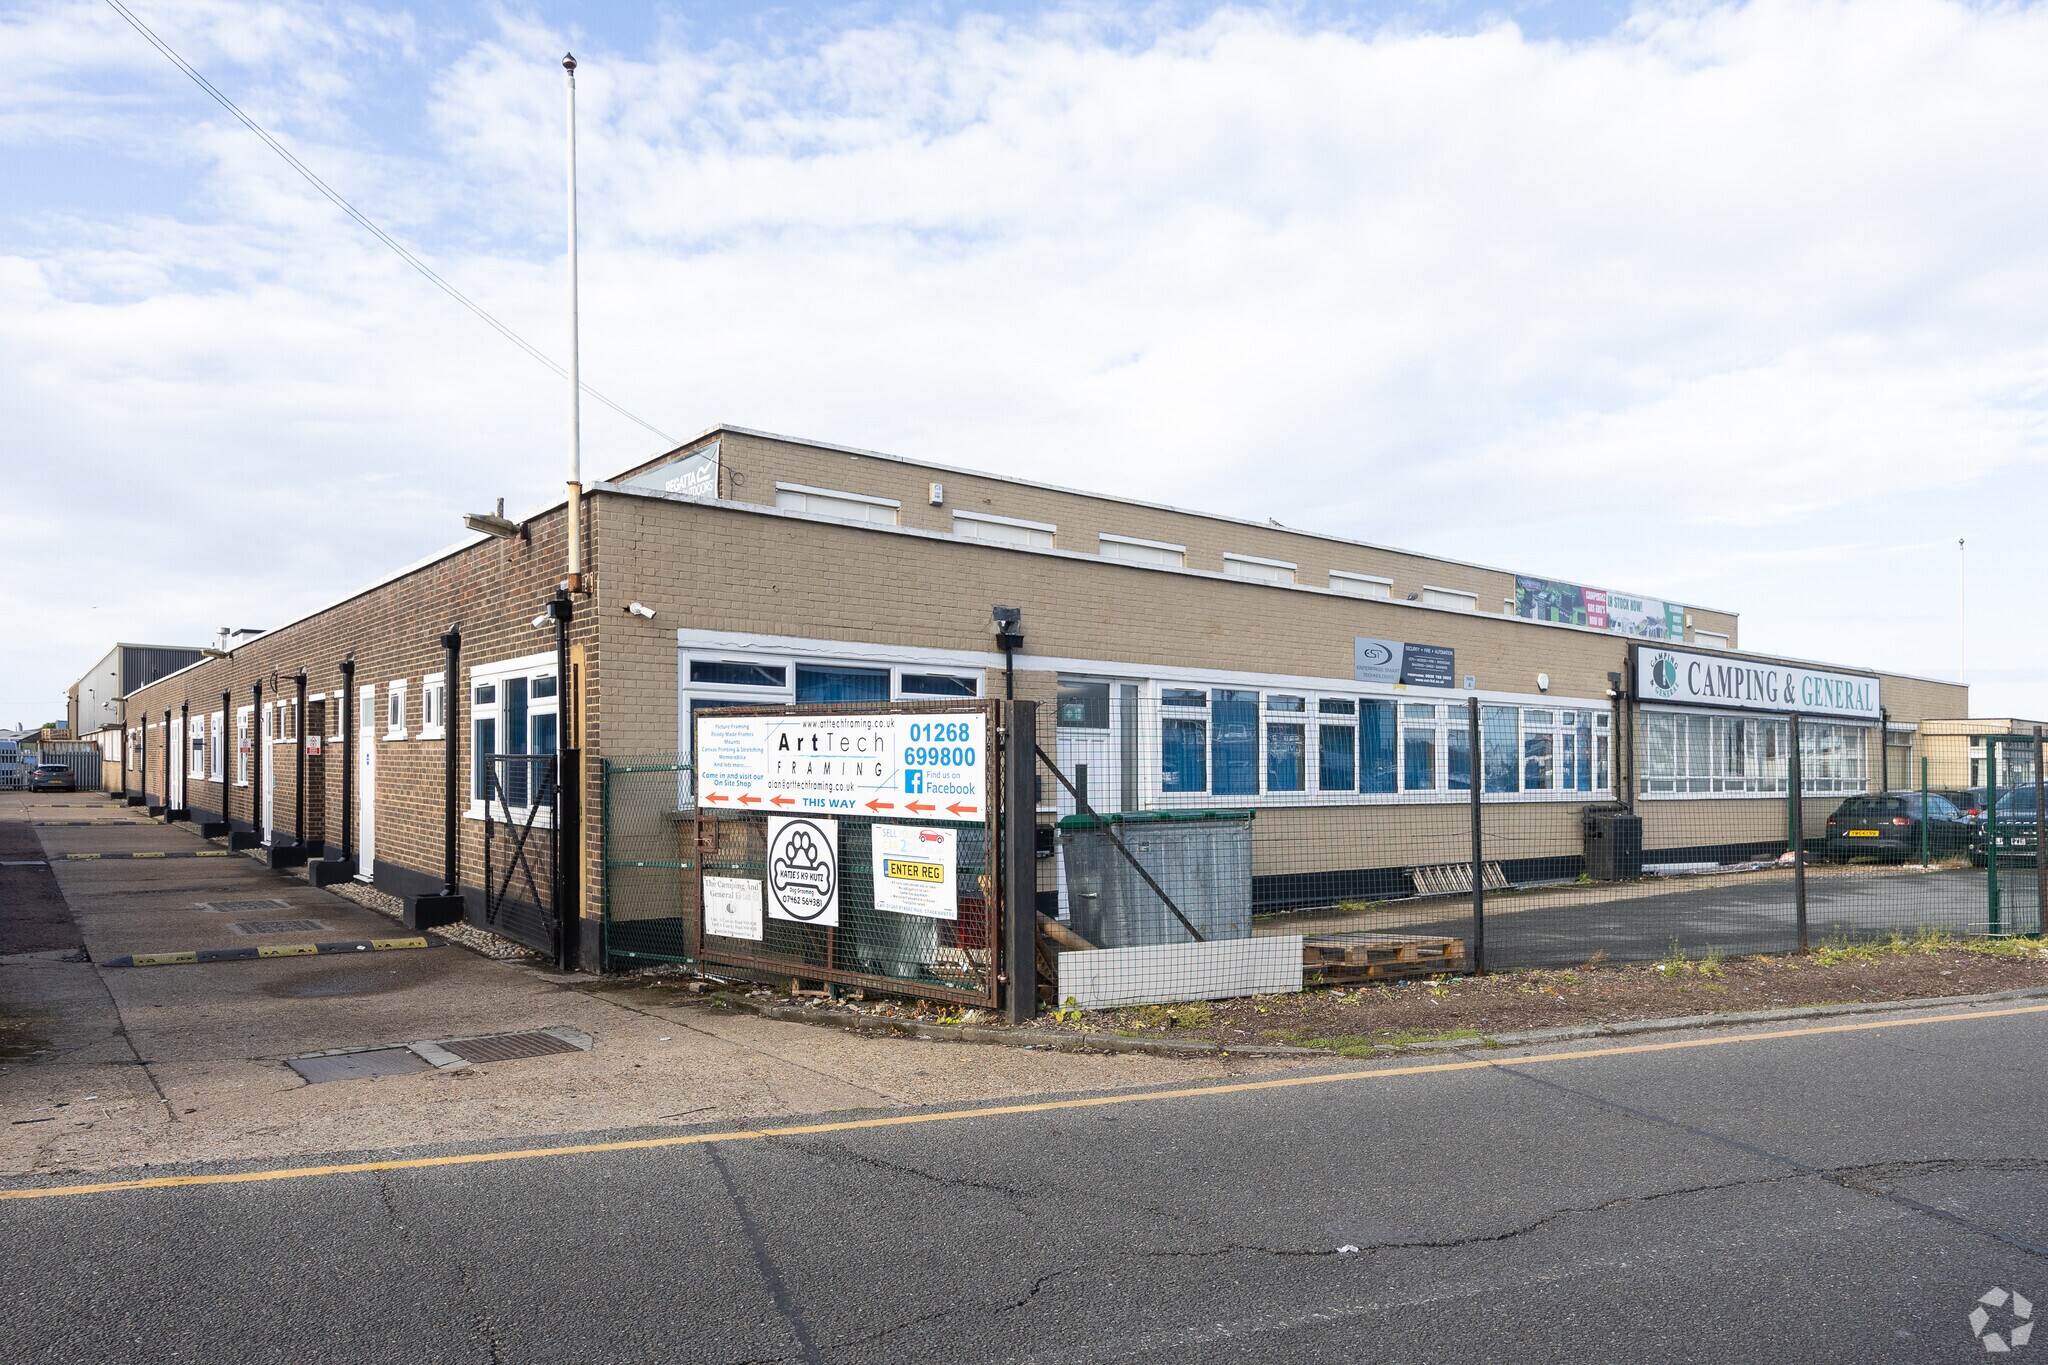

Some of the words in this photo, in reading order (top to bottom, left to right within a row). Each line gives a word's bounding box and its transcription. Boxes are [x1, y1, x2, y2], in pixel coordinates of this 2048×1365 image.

[665, 471, 696, 492] REGATTA
[1614, 597, 1629, 610] STOCK
[1651, 653, 1678, 669] CAMPING
[1356, 665, 1383, 673] ENTERPRISE
[1655, 682, 1679, 698] GENERAL
[1688, 661, 1778, 705] CAMPING
[1784, 673, 1795, 704] &
[1802, 675, 1873, 711] GENERAL
[802, 718, 895, 730] www.arttechframing.co.uk
[910, 723, 970, 742] 01268
[904, 747, 975, 766] 699800
[777, 761, 882, 776] FRAMING
[768, 779, 854, 793] alan@arttechframing.co.uk
[926, 782, 975, 794] Facebook
[802, 798, 825, 807] THIS
[829, 799, 856, 808] WAY
[883, 829, 897, 838] SELL
[780, 870, 799, 879] KATIE'S
[801, 872, 808, 880] K9
[810, 873, 824, 882] KUTZ
[891, 863, 918, 876] ENTER
[922, 866, 940, 878] REG
[718, 881, 745, 890] Camping
[710, 890, 734, 898] General
[798, 888, 814, 897] Grooming
[783, 895, 800, 904] 07462
[802, 897, 822, 907] 564381
